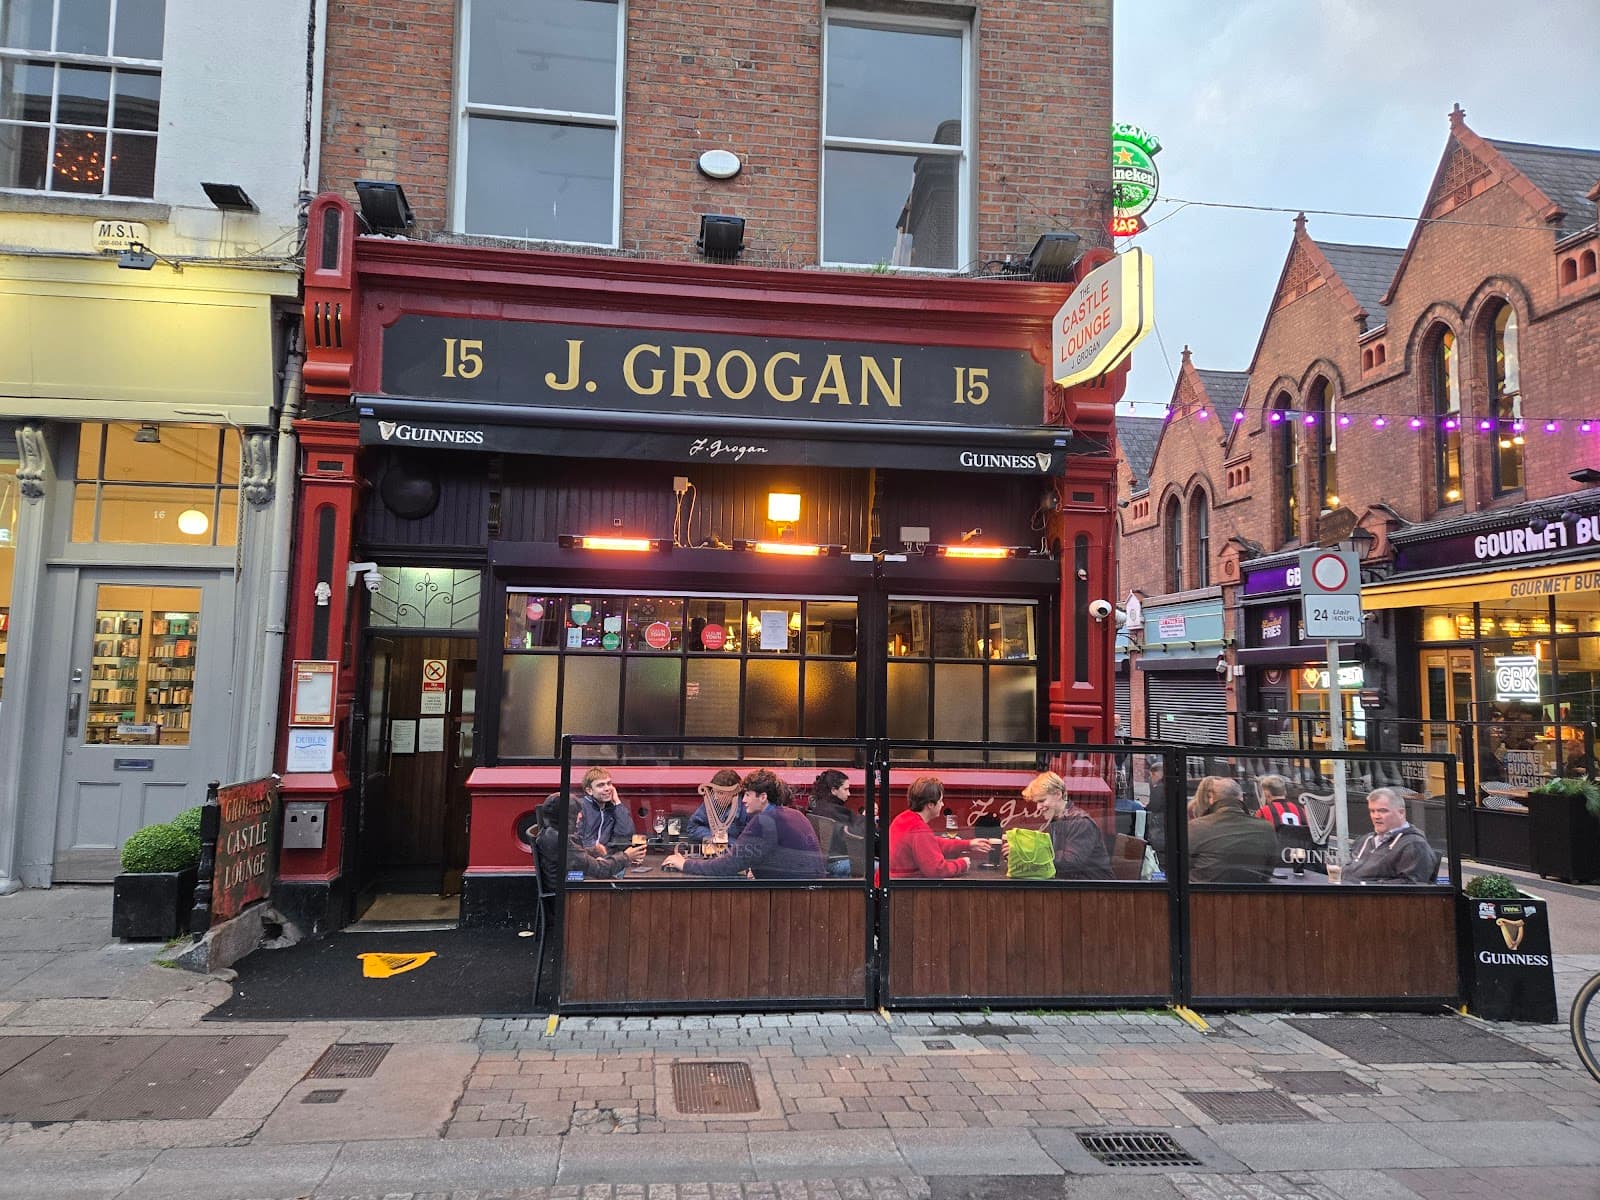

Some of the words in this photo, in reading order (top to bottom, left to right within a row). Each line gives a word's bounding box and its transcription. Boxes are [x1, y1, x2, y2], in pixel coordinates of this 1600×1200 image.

[98, 224, 140, 239] M.S.I.
[1080, 283, 1091, 300] THE
[1062, 279, 1110, 335] CASTLE
[1060, 306, 1111, 363] LOUNGE
[442, 338, 484, 379] 15
[1076, 341, 1101, 366] GROGAN
[544, 339, 598, 393] J.
[623, 343, 903, 408] GROGAN
[953, 366, 990, 406] 15
[395, 424, 484, 444] GUINNESS
[710, 439, 769, 462] Grogan
[959, 451, 1037, 470] GUINNESS
[154, 510, 166, 519] 16
[1474, 522, 1567, 559] GOURMET
[1286, 567, 1301, 587] GB
[1510, 577, 1571, 597] GOURMET
[1313, 609, 1329, 621] 24
[1496, 666, 1538, 692] GBK
[227, 821, 268, 855] CASTLE
[224, 851, 266, 890] LOUNGE
[1479, 950, 1549, 966] GUINNESS
